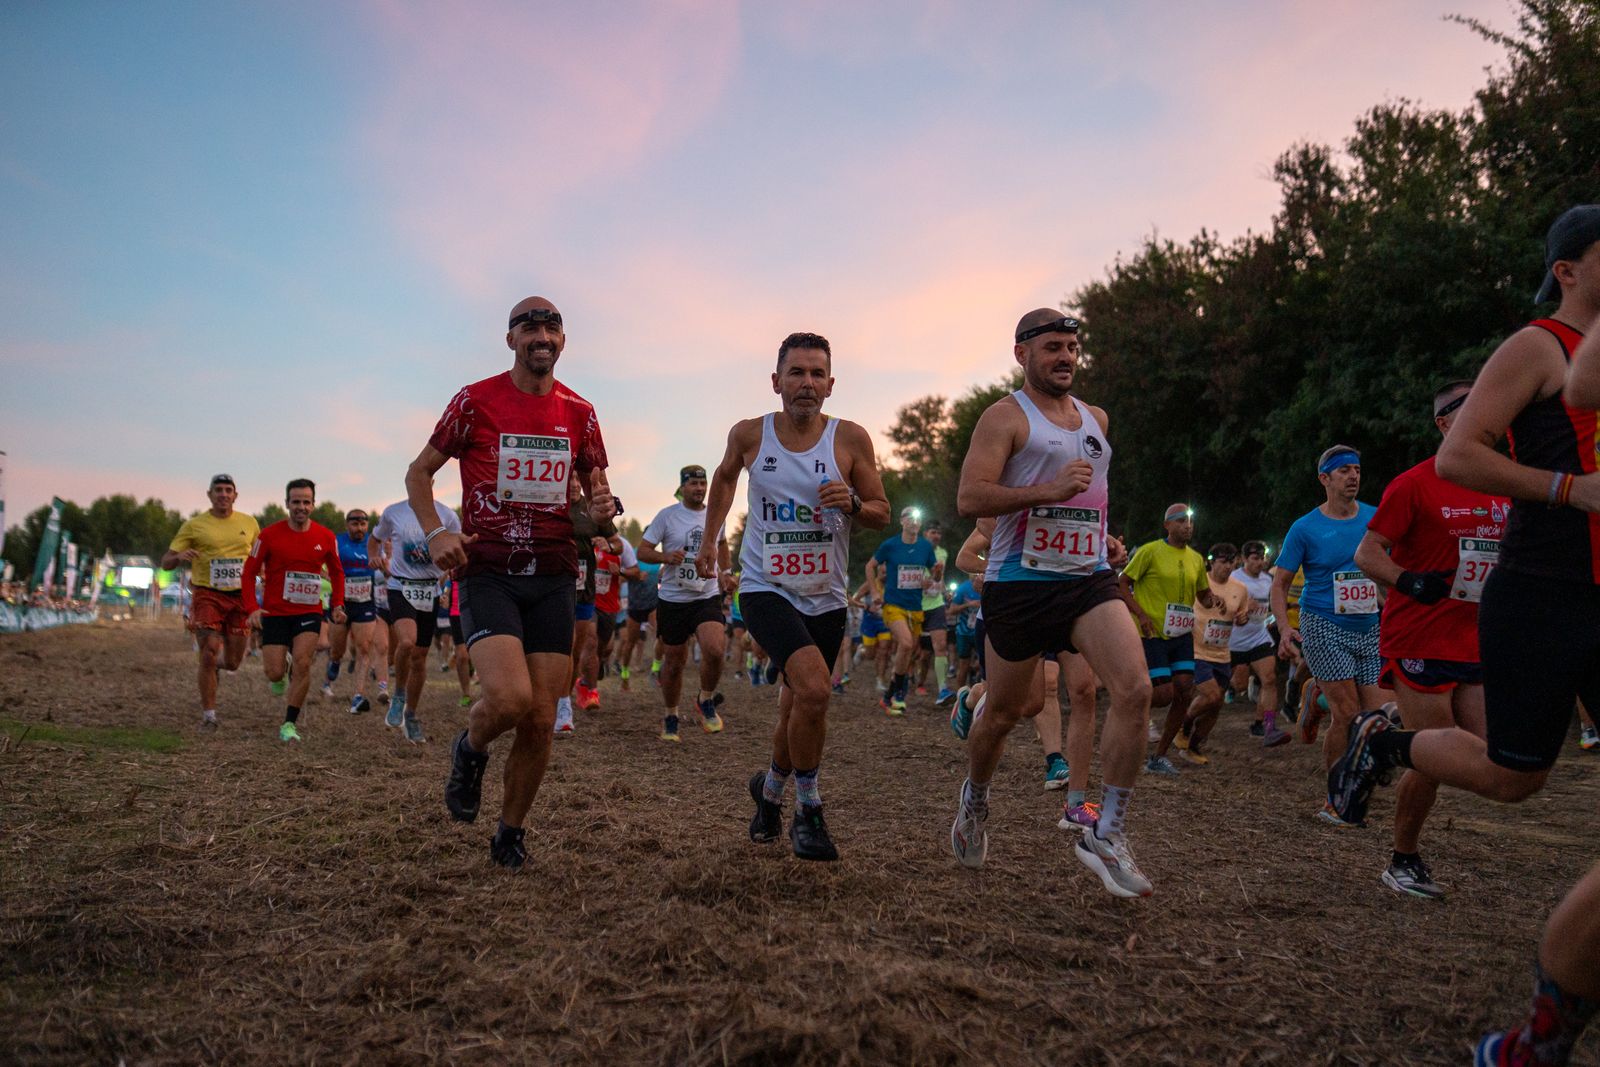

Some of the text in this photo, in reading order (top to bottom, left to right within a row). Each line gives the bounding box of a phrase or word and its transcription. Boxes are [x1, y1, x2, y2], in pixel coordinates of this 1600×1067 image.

[506, 458, 565, 483] 3120
[1032, 528, 1095, 557] 3411
[770, 552, 830, 576] 3851
[1463, 561, 1495, 583] 37
[213, 568, 242, 579] 3985
[287, 583, 319, 595] 3462
[404, 589, 432, 602] 3334
[1339, 585, 1375, 601] 3034
[1168, 615, 1194, 628] 3304
